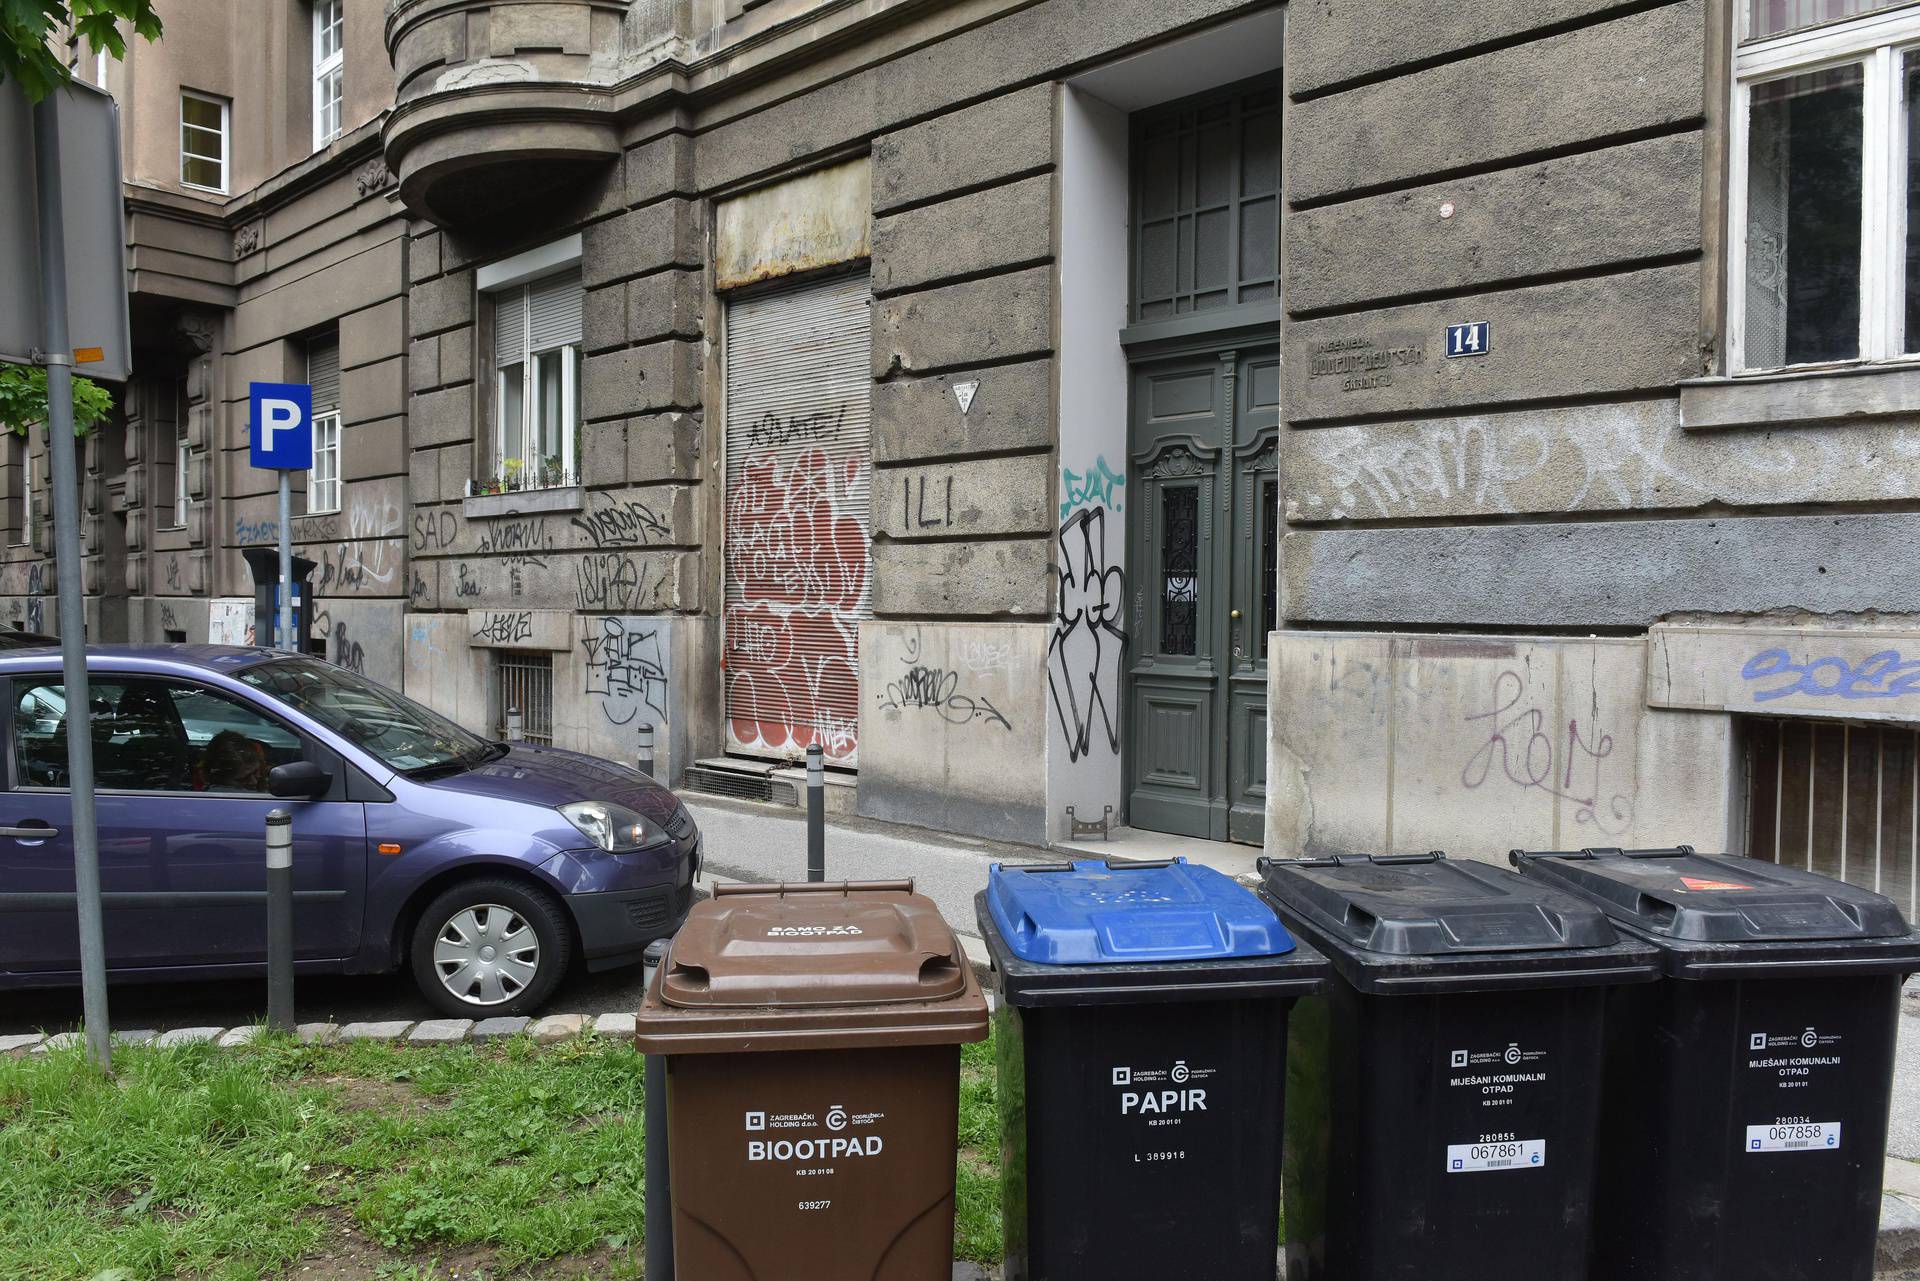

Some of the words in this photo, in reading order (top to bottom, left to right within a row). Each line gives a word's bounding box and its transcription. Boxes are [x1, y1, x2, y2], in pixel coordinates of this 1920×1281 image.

[1454, 325, 1480, 353] 14
[260, 398, 302, 452] P
[414, 511, 457, 551] SAD
[1749, 1058, 1788, 1068] MIJEŠANI
[1790, 1056, 1840, 1066] KOMUNALNI
[1779, 1068, 1809, 1076] OTPAD
[1450, 1076, 1490, 1086] MIJEŠANI
[1493, 1073, 1546, 1083] KOMUNALNI
[1482, 1085, 1513, 1094] OTPAD
[1122, 1089, 1207, 1114] PAPIR
[1776, 1116, 1810, 1125] 280034
[1480, 1133, 1515, 1142] 280855
[1770, 1126, 1821, 1140] 067858
[748, 1136, 883, 1160] BIOOTPAD
[1471, 1143, 1524, 1160] 067861
[799, 1201, 830, 1210] 639277
